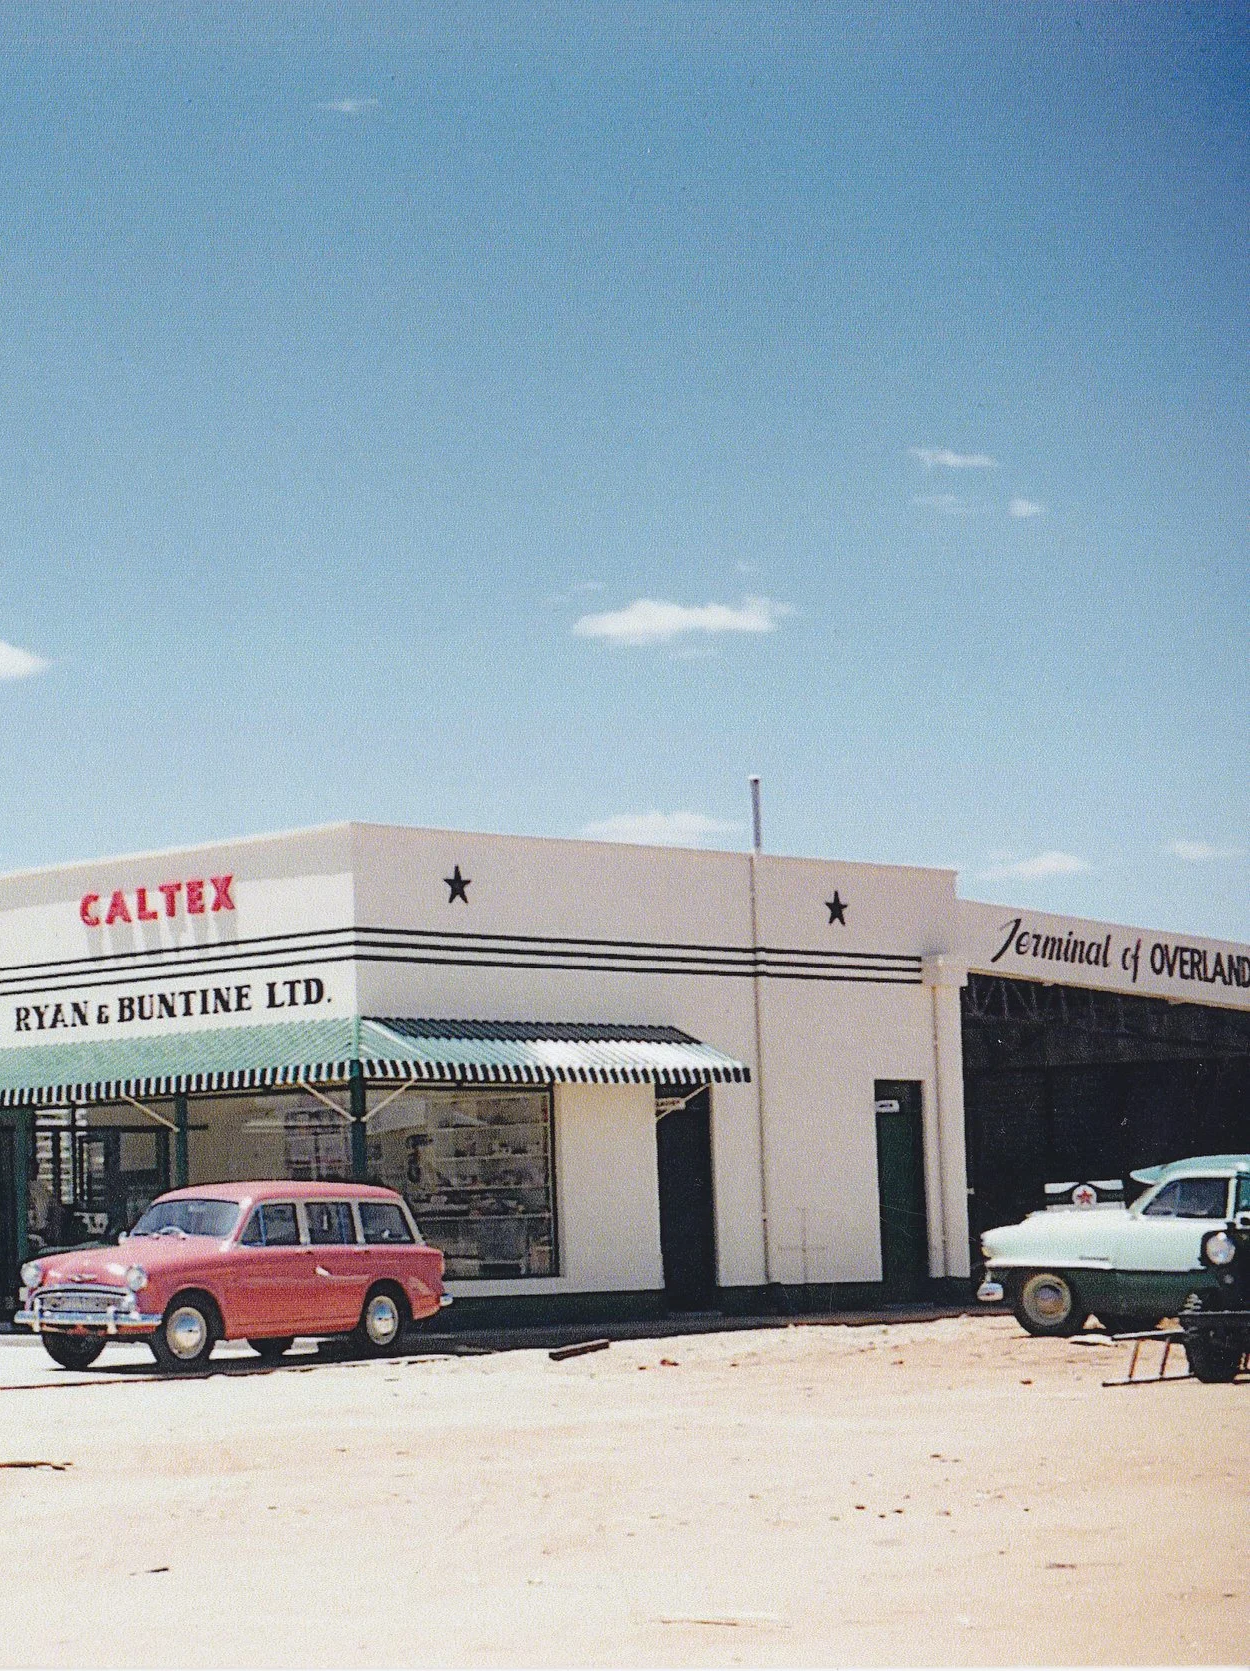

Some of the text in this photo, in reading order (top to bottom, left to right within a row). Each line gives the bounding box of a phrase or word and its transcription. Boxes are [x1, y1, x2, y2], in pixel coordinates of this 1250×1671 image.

[80, 873, 236, 926] CALTEX
[990, 918, 1250, 988] Terminal of OVERLAND
[14, 977, 333, 1032] RYAN & BUNTINE LTD.
